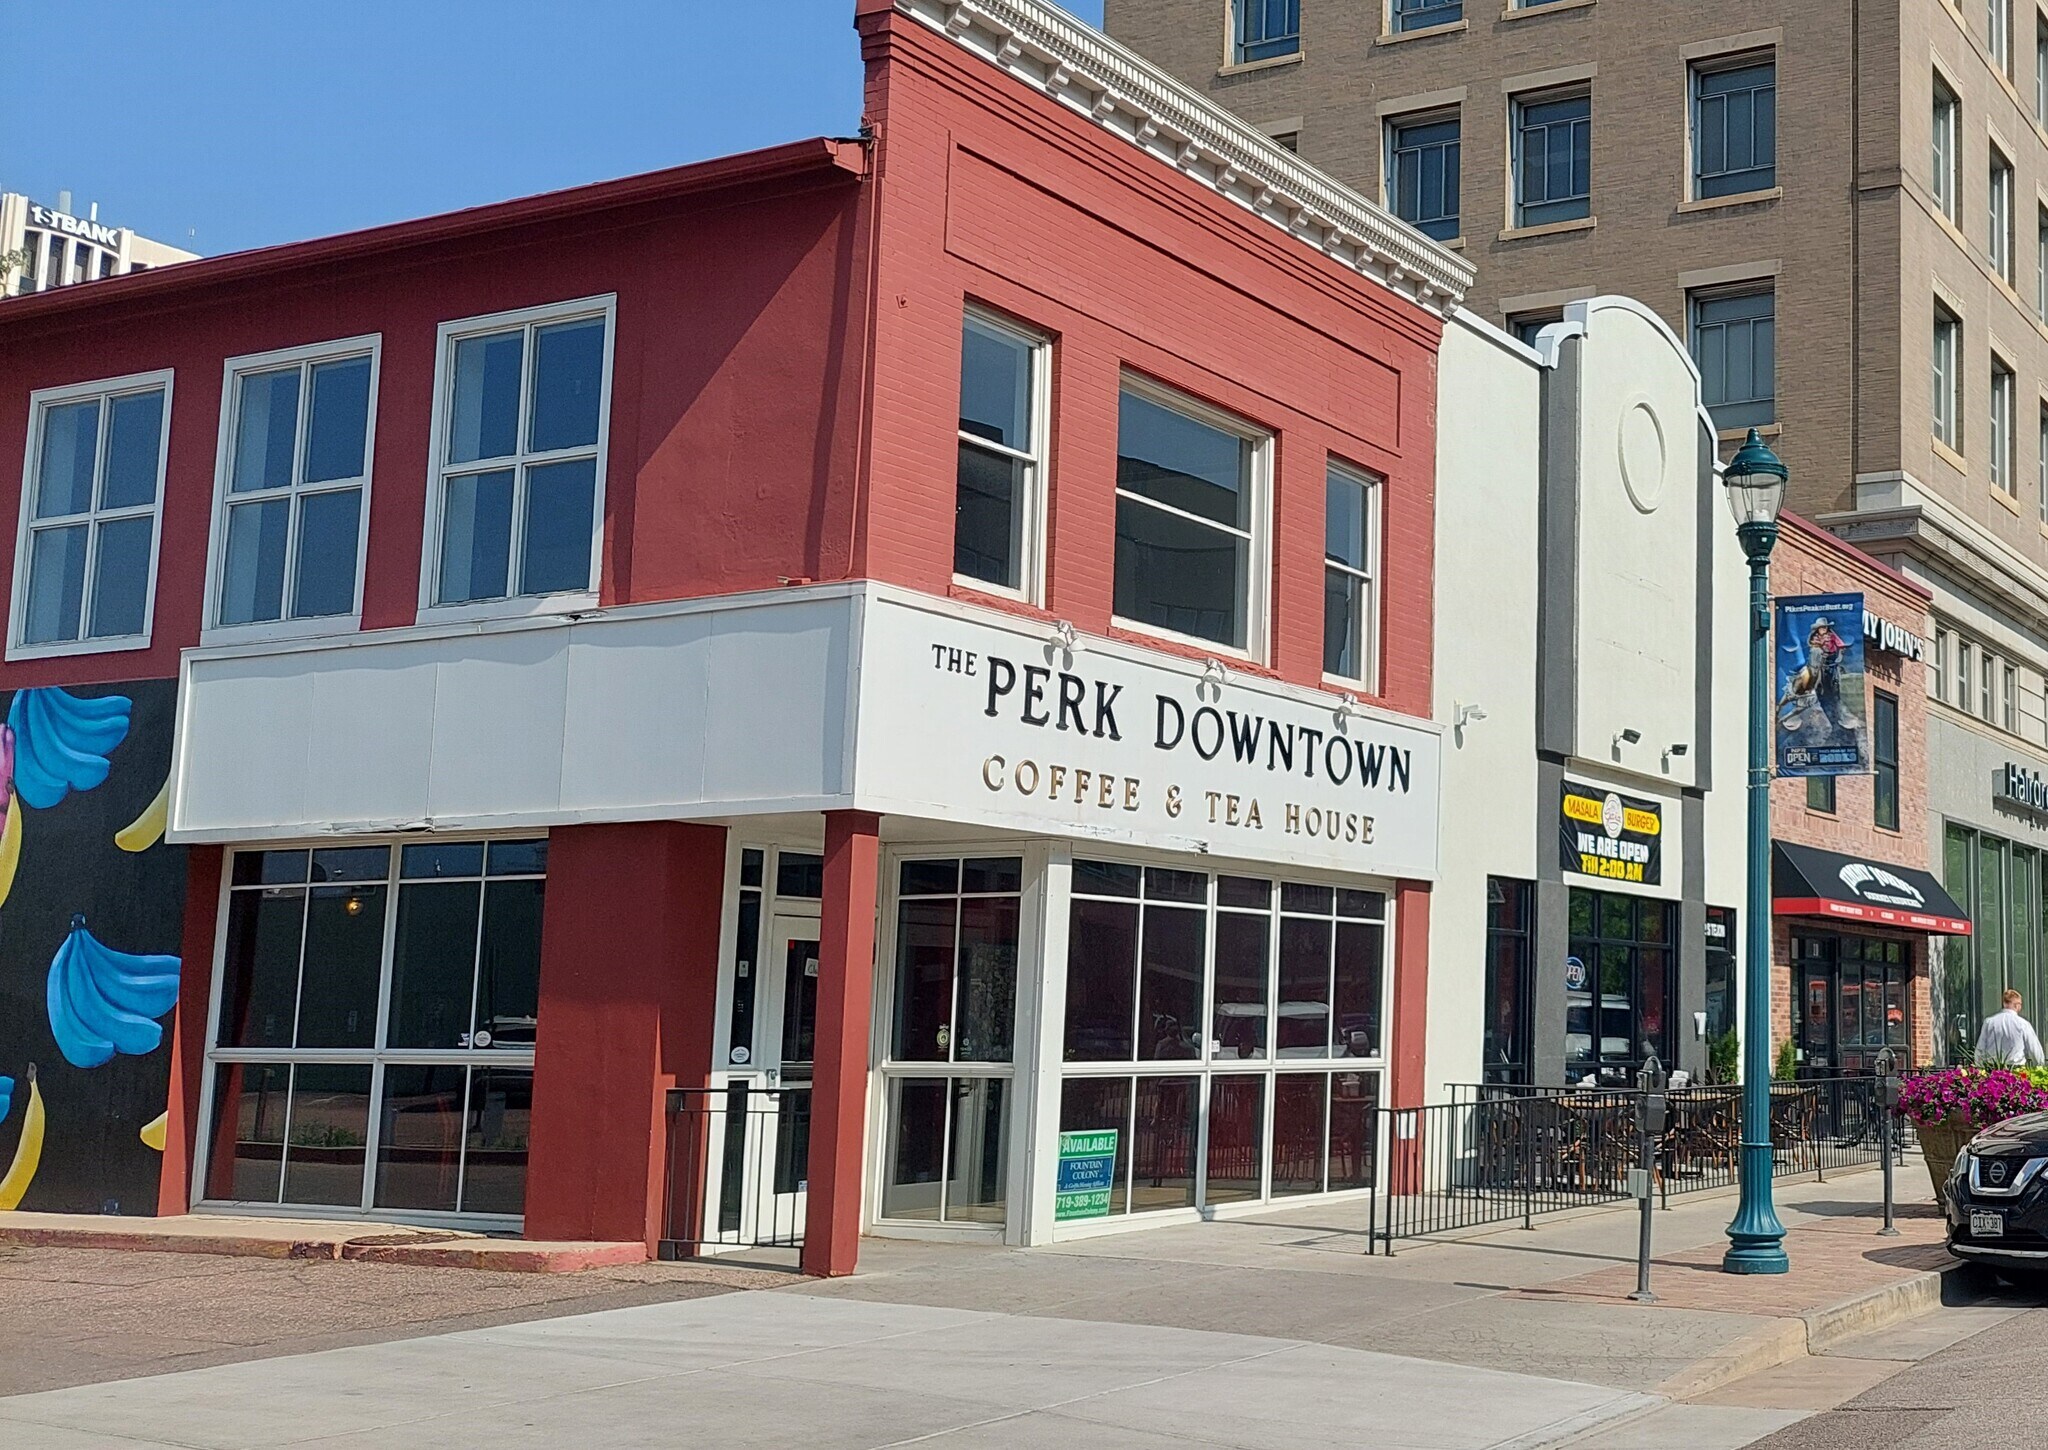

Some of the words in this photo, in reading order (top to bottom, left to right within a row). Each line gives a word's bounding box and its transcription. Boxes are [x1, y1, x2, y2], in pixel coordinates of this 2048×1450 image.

[1880, 618, 1925, 662] JOHN'S
[931, 643, 978, 676] THE
[984, 655, 1123, 742] PERK
[1153, 694, 1411, 794] DOWNTOWN
[1787, 752, 1811, 764] OPEN
[982, 754, 1141, 811] COFFEE
[1166, 784, 1182, 818] &
[1205, 791, 1263, 830] TEA
[1284, 803, 1376, 845] HOUSE
[1568, 798, 1599, 820] MASALA
[1627, 812, 1656, 831] BURGER
[1577, 831, 1596, 854] WE
[1596, 836, 1618, 858] ARE
[1619, 840, 1649, 863] OPEN
[1599, 858, 1625, 879] 2:00
[1625, 862, 1643, 881] AM
[1062, 1136, 1114, 1153] AVAILABLE
[1070, 1161, 1103, 1171] FOUNTAIN
[1072, 1170, 1099, 1180] COLONY
